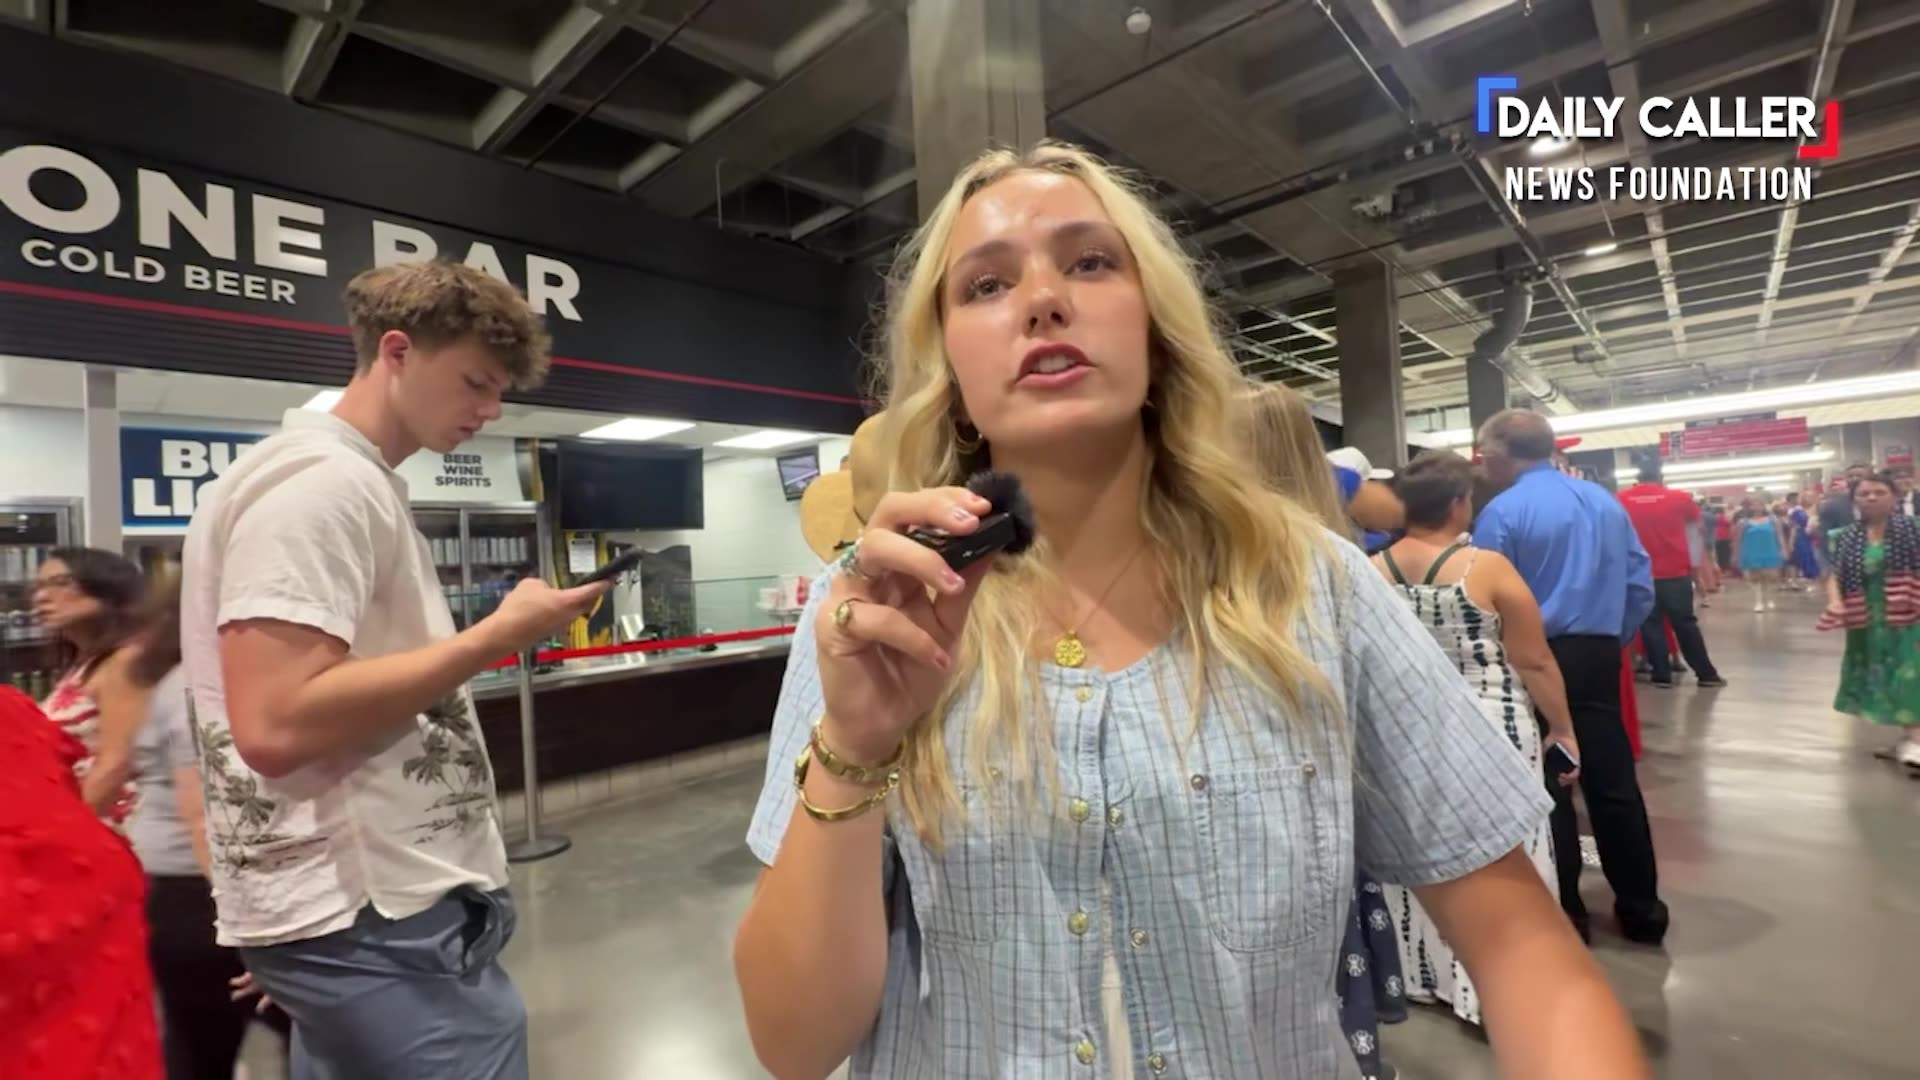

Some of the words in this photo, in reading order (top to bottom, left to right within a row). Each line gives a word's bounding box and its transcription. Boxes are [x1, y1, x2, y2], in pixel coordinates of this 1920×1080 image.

[0, 145, 328, 277] ONE
[20, 239, 166, 283] COLD
[184, 264, 297, 304] BEER
[161, 439, 253, 478] BU
[443, 454, 482, 464] BEER
[443, 464, 483, 475] WINE
[132, 478, 214, 517] LI
[434, 475, 492, 487] SPIRITS
